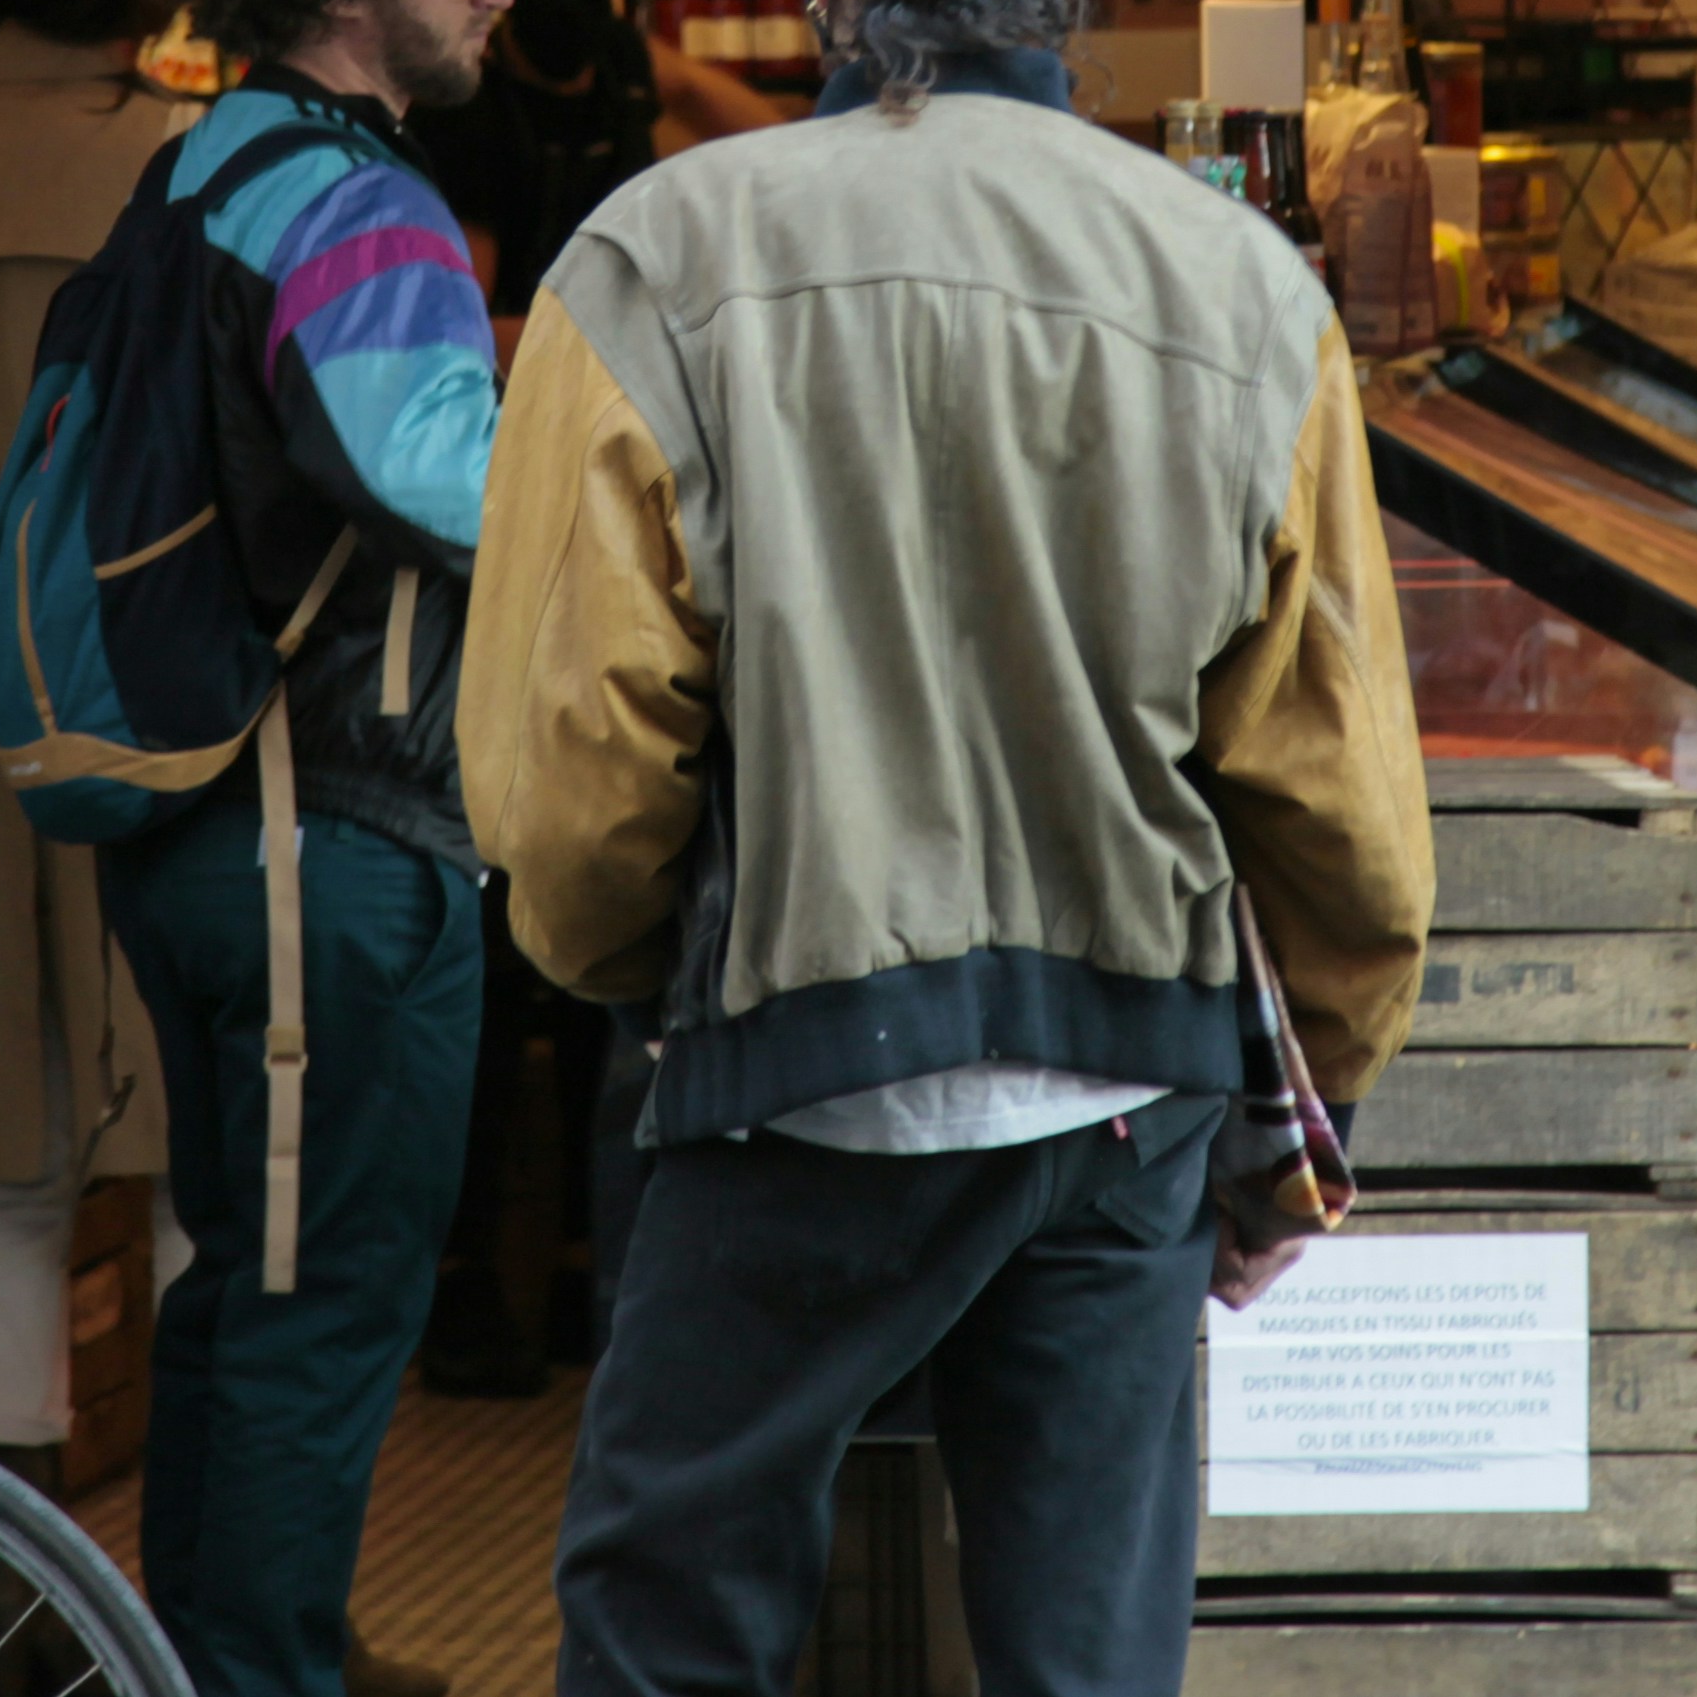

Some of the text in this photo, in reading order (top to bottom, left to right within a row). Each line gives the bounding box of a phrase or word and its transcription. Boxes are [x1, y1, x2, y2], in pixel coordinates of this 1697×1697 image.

[1305, 1284, 1411, 1305] ACCEPTONS
[1416, 1283, 1446, 1302] LES
[1450, 1283, 1521, 1303] DEPOTS
[1524, 1282, 1546, 1301] DE
[1259, 1309, 1538, 1334] MASQUES EN TISSU FABRIQUÉS
[1287, 1342, 1511, 1363] PAR VOS SOINS POUR LES
[1242, 1374, 1346, 1393] DISTRIBUER
[1369, 1373, 1416, 1391] CEUX
[1421, 1372, 1454, 1390] QUI
[1522, 1370, 1556, 1388] PAS
[1247, 1405, 1269, 1422] LA
[1274, 1399, 1377, 1422] POSSIBILITÉ
[1382, 1403, 1403, 1420] DE
[1456, 1399, 1551, 1418] PROCURER
[1298, 1432, 1326, 1451] OU
[1331, 1432, 1355, 1450] DE
[1360, 1431, 1389, 1449] LES
